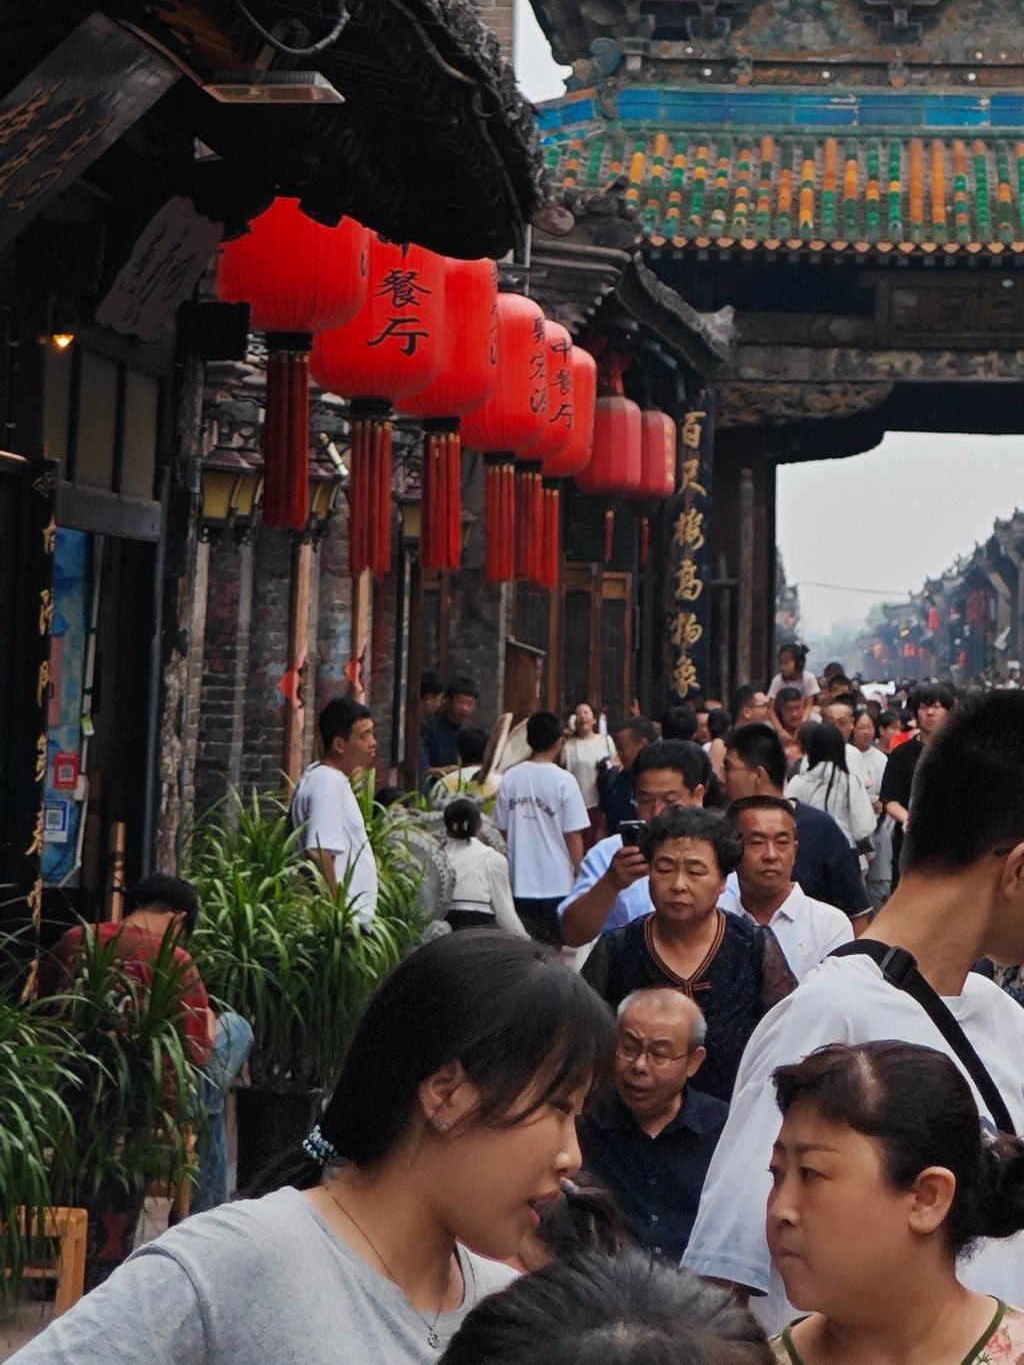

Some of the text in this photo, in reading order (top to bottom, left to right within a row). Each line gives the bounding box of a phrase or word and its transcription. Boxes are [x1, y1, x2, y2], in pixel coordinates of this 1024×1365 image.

[365, 243, 432, 356] 餐厅
[548, 337, 574, 430] 中餐厅
